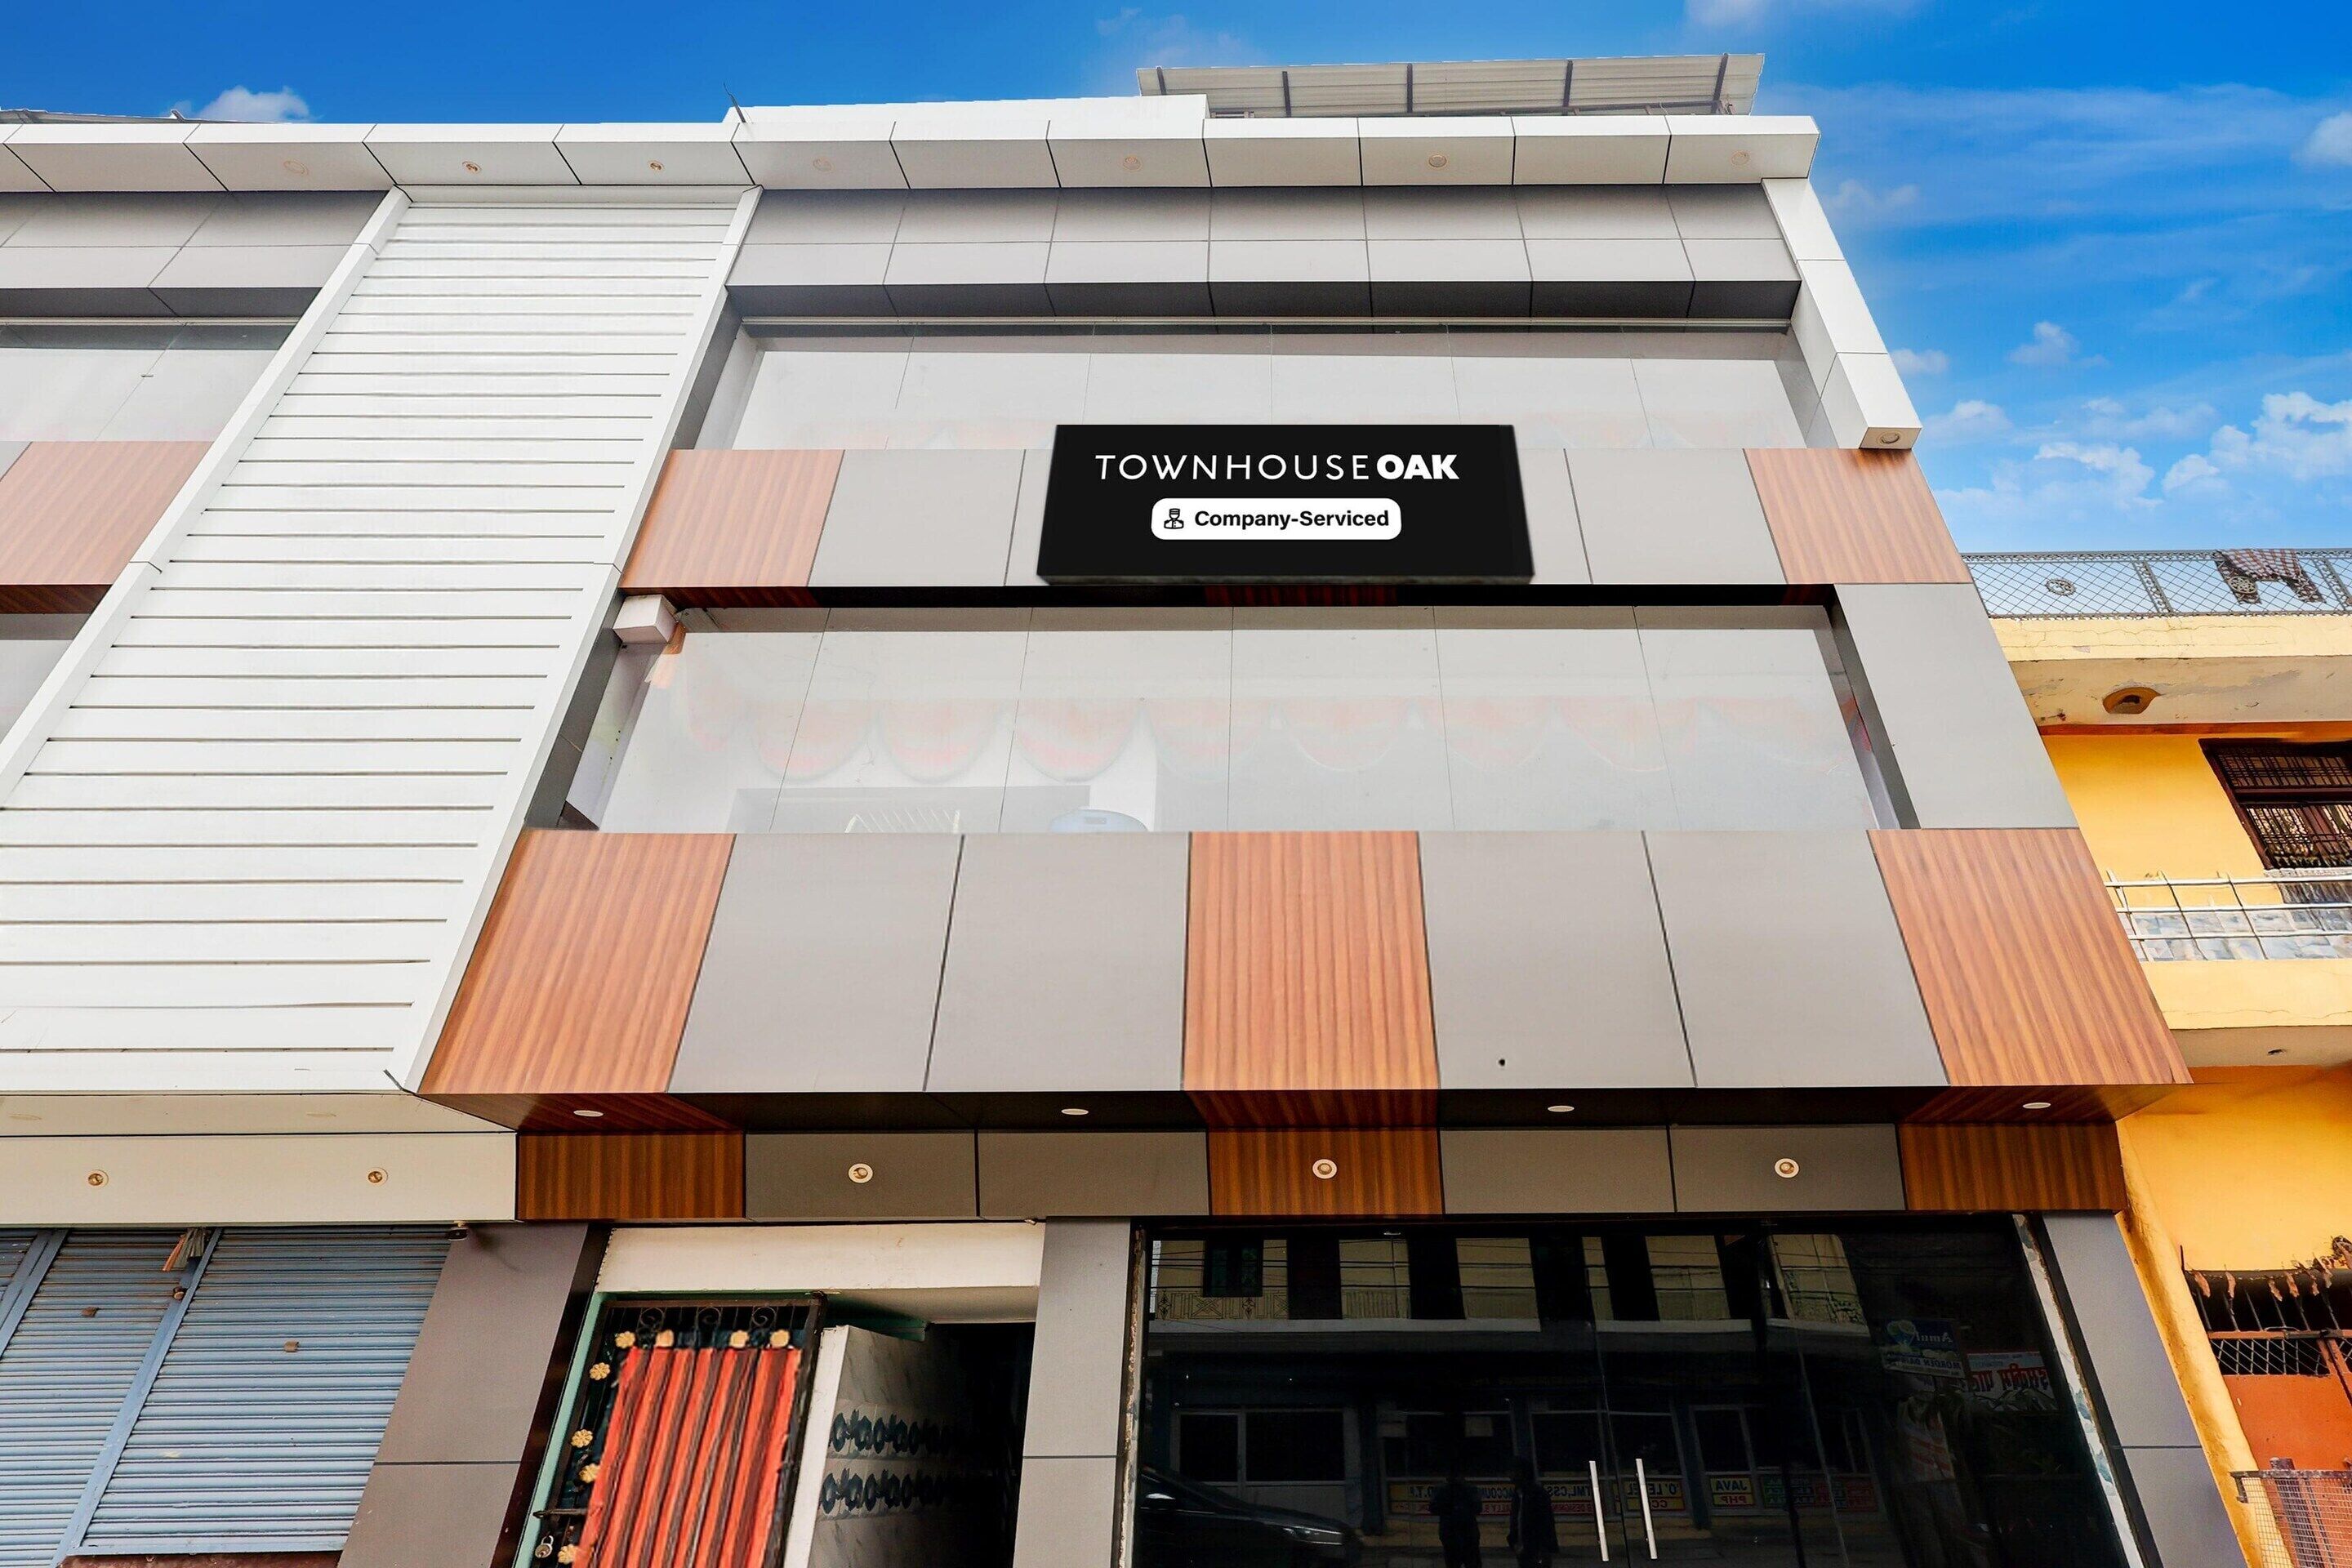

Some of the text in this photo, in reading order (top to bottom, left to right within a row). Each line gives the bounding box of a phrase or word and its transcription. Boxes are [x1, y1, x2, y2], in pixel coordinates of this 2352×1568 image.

[1096, 455, 1459, 479] TOWNHOUSE OAK
[1196, 510, 1388, 530] Company-Serviced
